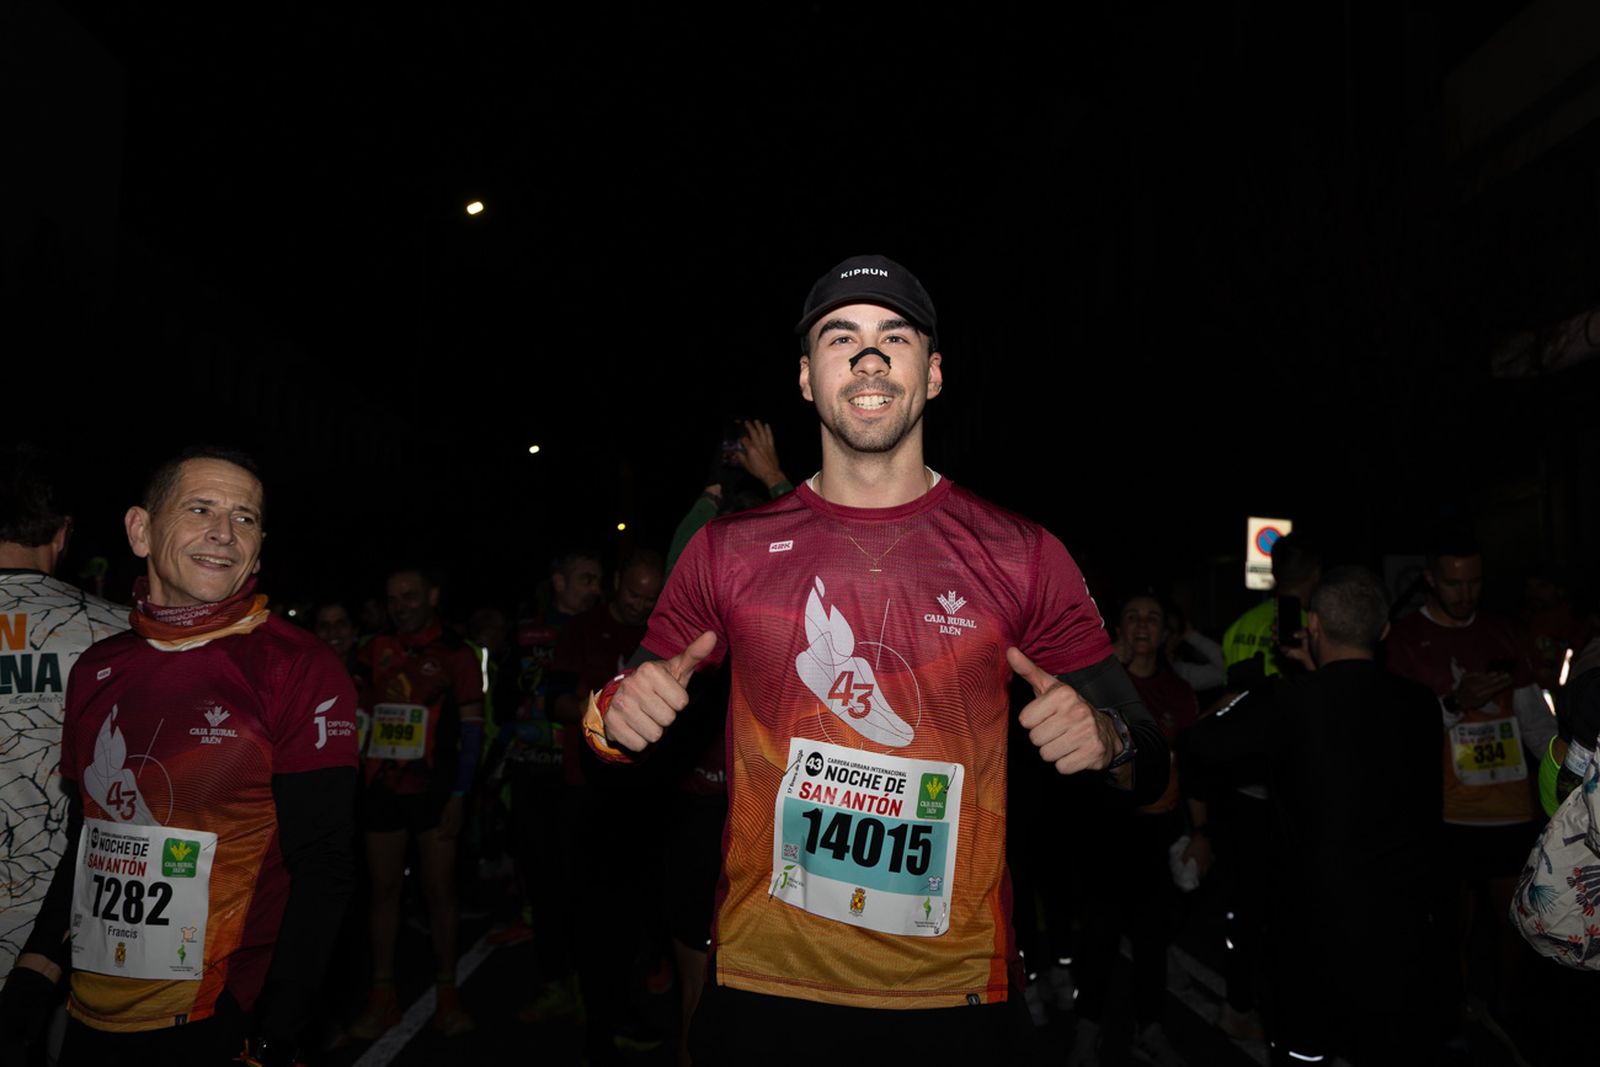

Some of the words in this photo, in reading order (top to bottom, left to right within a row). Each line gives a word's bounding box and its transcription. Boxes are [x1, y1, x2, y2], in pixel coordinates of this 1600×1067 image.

[840, 267, 889, 279] KIPRUN
[923, 613, 946, 624] CAJA
[947, 615, 977, 629] RURAL
[827, 670, 874, 719] 43
[189, 727, 208, 736] CAJA
[209, 728, 238, 738] RURAL
[806, 755, 823, 771] 43
[827, 757, 850, 767] CARRERA
[850, 761, 870, 771] URBANA
[1473, 742, 1505, 764] 334
[824, 765, 882, 790] NOCHE
[884, 777, 907, 795] DE
[106, 780, 136, 820] 43
[799, 781, 838, 805] SAN
[839, 790, 903, 817] ANTÓN
[99, 837, 130, 855] NOCHE
[132, 841, 150, 857] DE
[802, 807, 933, 876] 14015
[87, 853, 106, 870] SAN
[106, 856, 147, 877] ANTÓN
[92, 874, 173, 926] 7282
[107, 925, 138, 939] Francis
